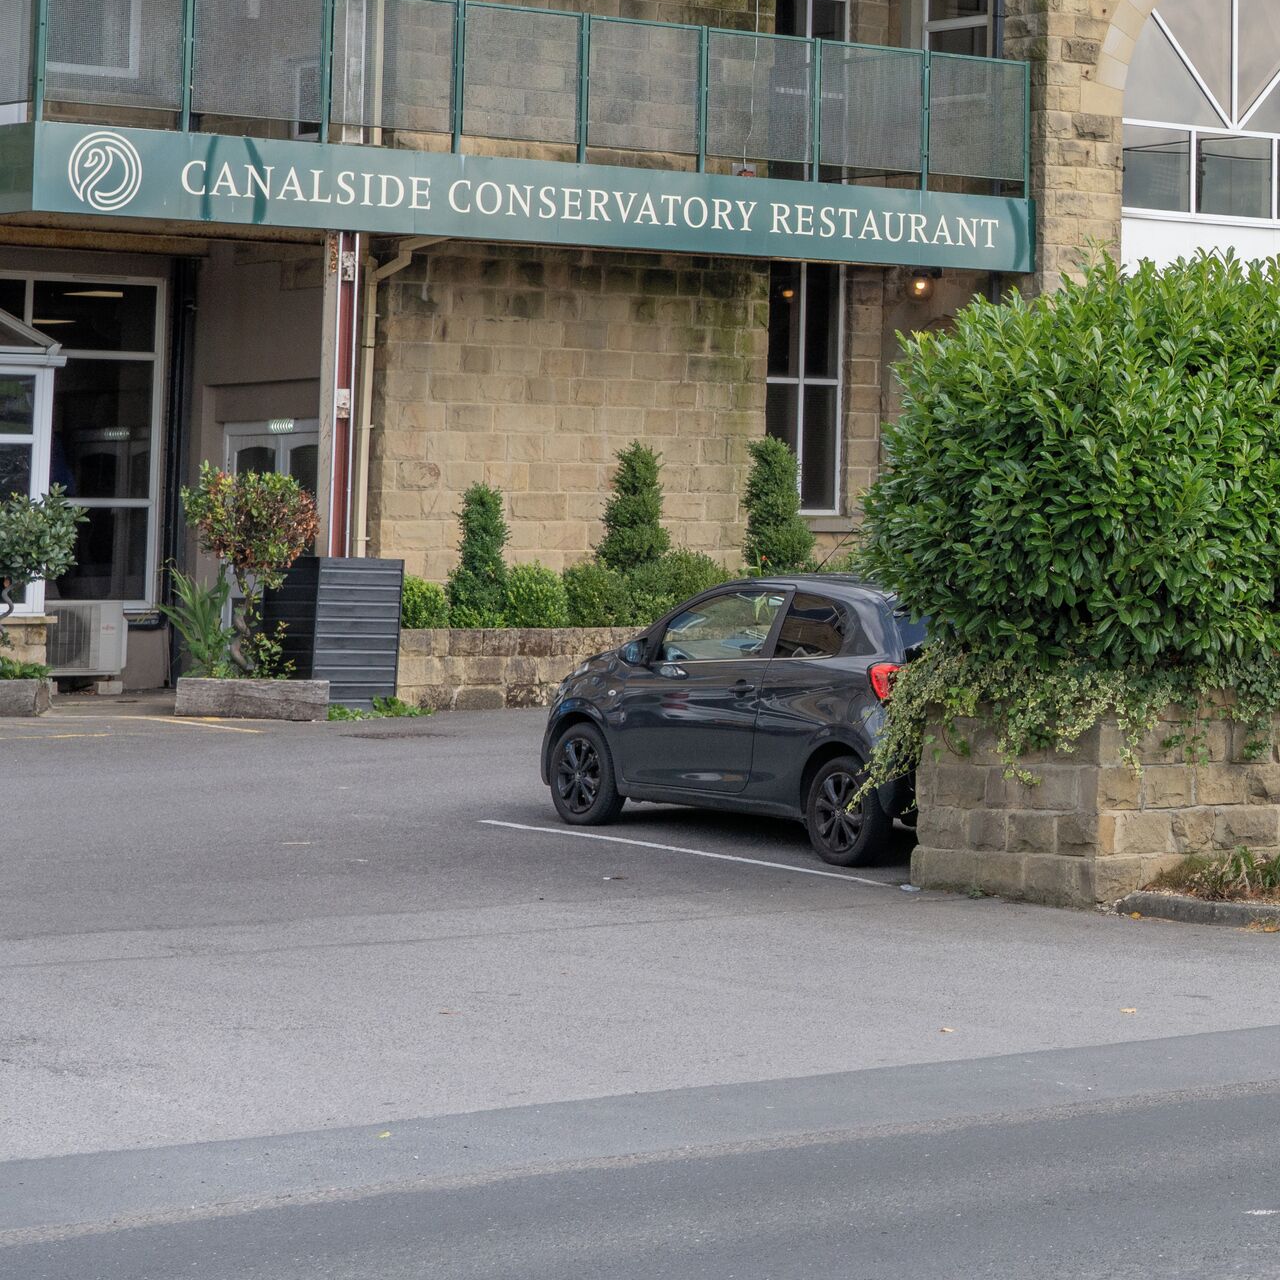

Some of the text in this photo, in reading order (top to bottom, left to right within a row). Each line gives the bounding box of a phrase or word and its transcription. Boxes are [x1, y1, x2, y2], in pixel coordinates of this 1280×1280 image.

[181, 160, 1002, 250] CANALSIDE CONSERVATORY RESTAURANT
